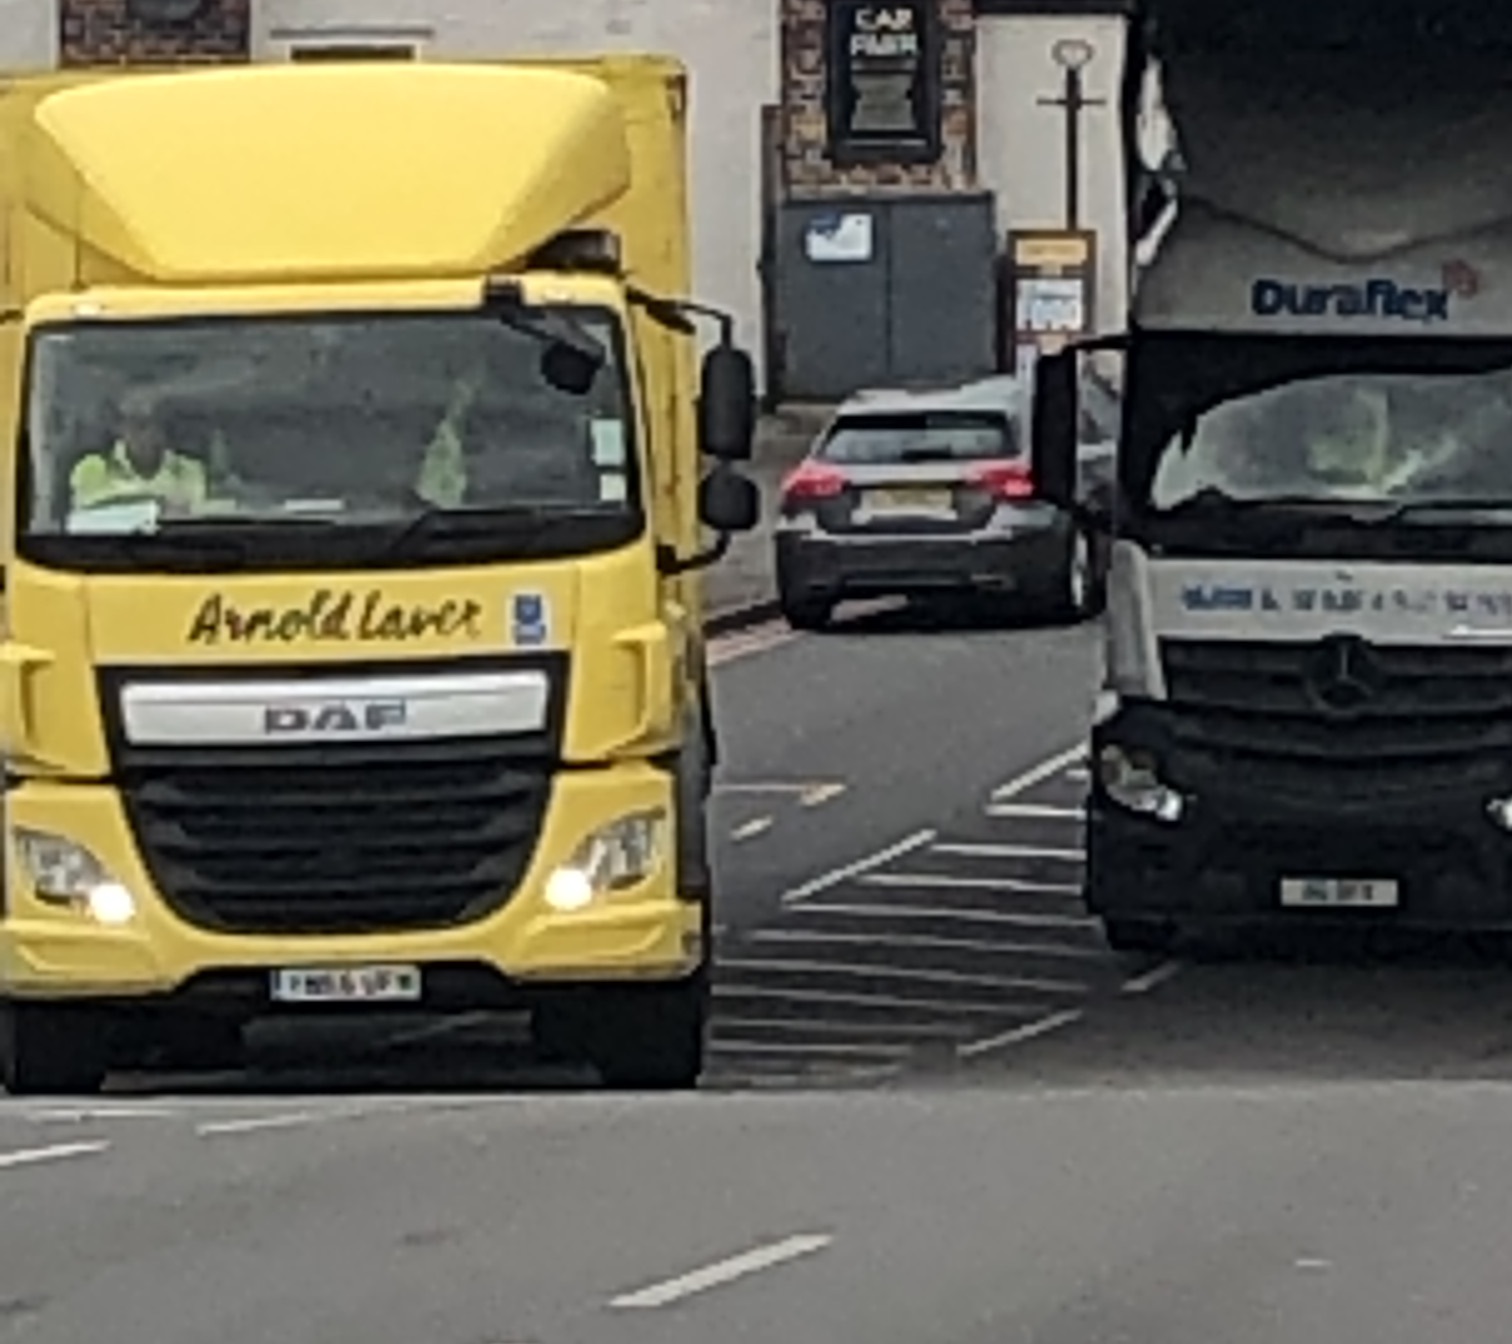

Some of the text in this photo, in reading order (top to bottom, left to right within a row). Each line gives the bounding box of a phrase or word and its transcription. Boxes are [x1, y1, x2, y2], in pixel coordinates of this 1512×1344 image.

[855, 8, 913, 31] CAR
[1252, 278, 1449, 322] Duraflex
[186, 588, 354, 645] Arnold
[357, 588, 482, 641] Laver
[264, 698, 407, 735] DAF
